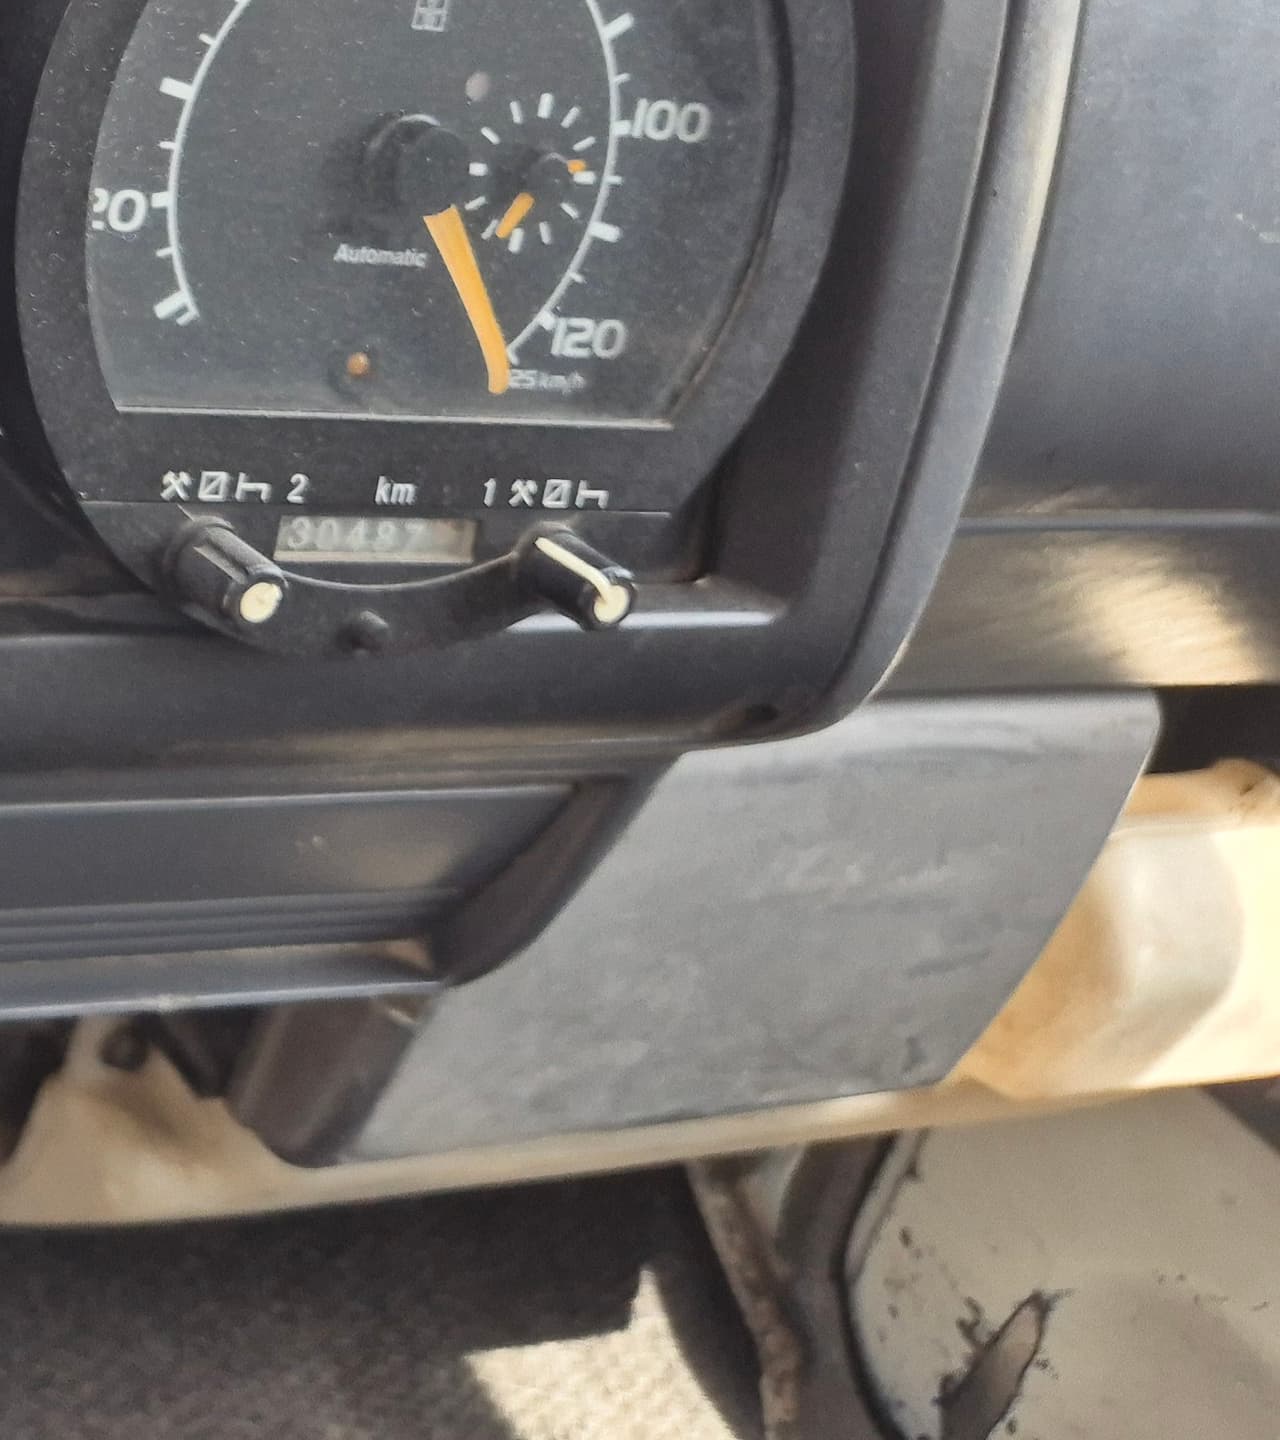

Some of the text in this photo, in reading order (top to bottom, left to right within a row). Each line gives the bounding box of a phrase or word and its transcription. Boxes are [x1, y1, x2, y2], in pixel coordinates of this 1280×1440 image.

[635, 99, 711, 143] 100
[551, 317, 628, 359] 120
[286, 472, 310, 505] 2
[374, 475, 417, 506] km
[482, 476, 497, 507] 1
